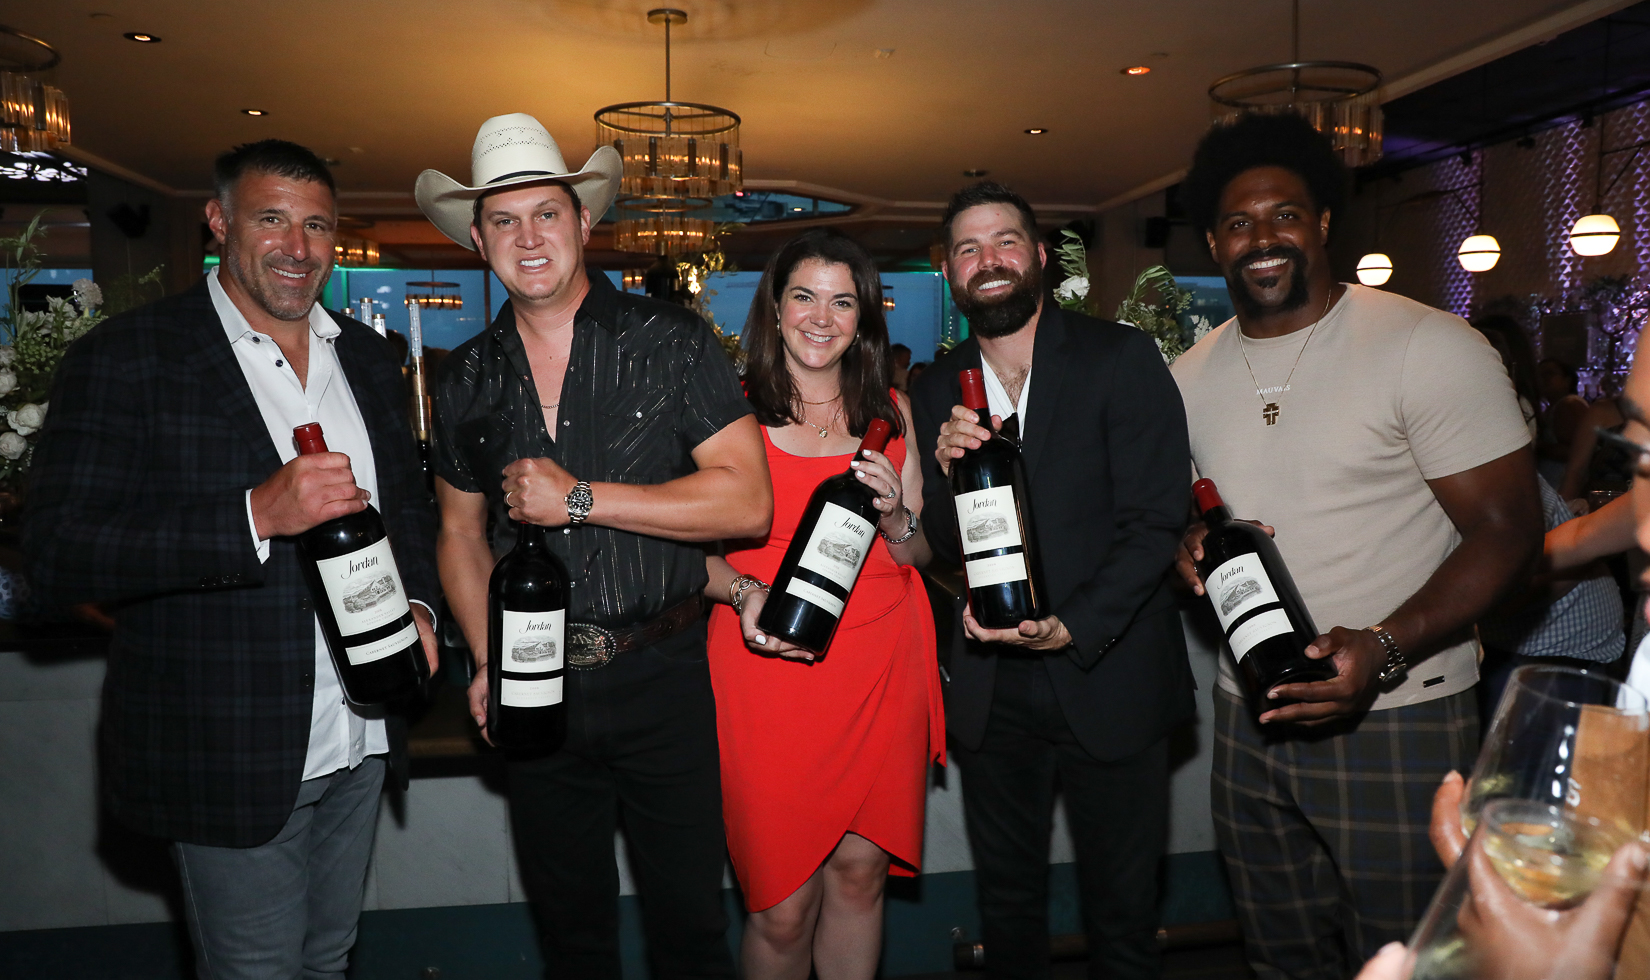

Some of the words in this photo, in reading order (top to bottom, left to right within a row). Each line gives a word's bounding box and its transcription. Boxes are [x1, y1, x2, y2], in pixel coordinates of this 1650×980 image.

[967, 498, 997, 514] Jordan
[834, 517, 866, 538] Jordan
[341, 556, 379, 579] Jordan
[1217, 565, 1244, 590] Jordan
[519, 619, 552, 634] Jordan
